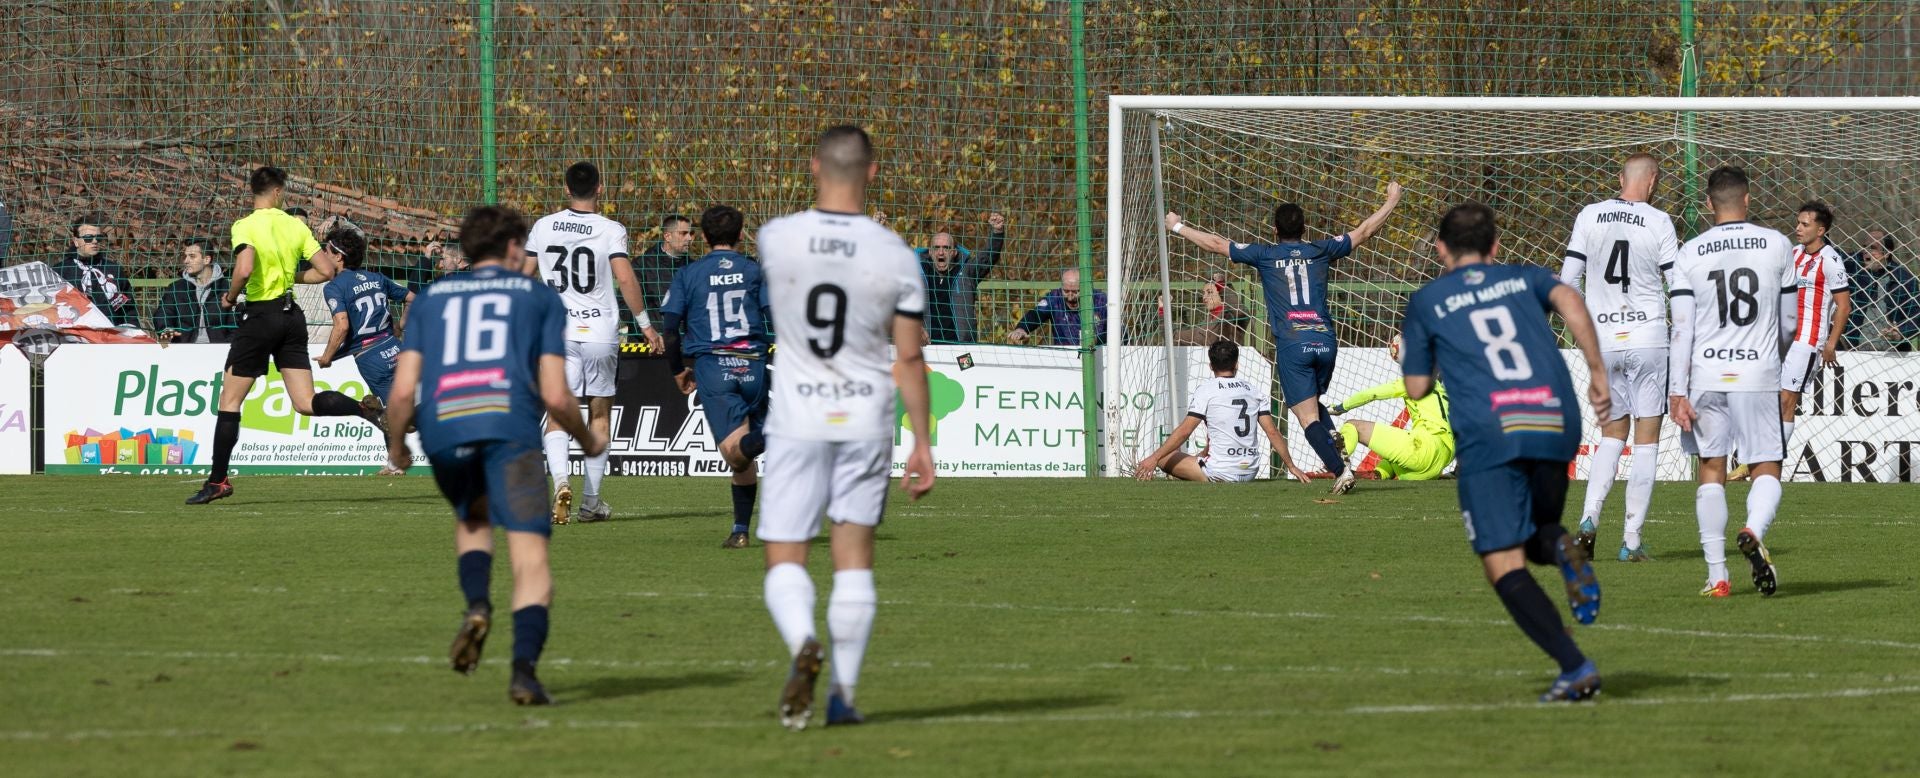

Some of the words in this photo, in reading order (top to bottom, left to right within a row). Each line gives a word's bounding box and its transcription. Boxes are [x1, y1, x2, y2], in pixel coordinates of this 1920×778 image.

[552, 221, 593, 235] GARRIDO
[1596, 210, 1646, 228] MONREAL
[808, 236, 857, 257] LUPU
[1697, 237, 1767, 256] CABALLERO
[545, 245, 596, 294] 30
[1603, 239, 1631, 293] 4
[709, 273, 744, 286] IKER
[1284, 264, 1311, 306] 11
[1445, 291, 1475, 312] SAN
[1707, 267, 1760, 329] 18
[355, 292, 390, 335] 22
[706, 289, 750, 341] 19
[806, 283, 848, 358] 9
[442, 293, 512, 366] 16
[1469, 305, 1533, 381] 8
[1231, 398, 1251, 438] 3
[313, 423, 326, 438] La
[334, 422, 373, 441] Rioja
[241, 443, 269, 452] Bolsas
[272, 445, 278, 453] y
[279, 443, 305, 453] papel
[307, 443, 346, 452] anónimo
[250, 454, 272, 463] para
[274, 451, 318, 461] hostelería
[320, 454, 326, 463] y
[328, 452, 371, 463] productos
[373, 452, 383, 461] de
[622, 461, 685, 476] 941221859
[952, 463, 959, 474] y
[962, 461, 1042, 472] herramientas
[1045, 461, 1060, 472] de
